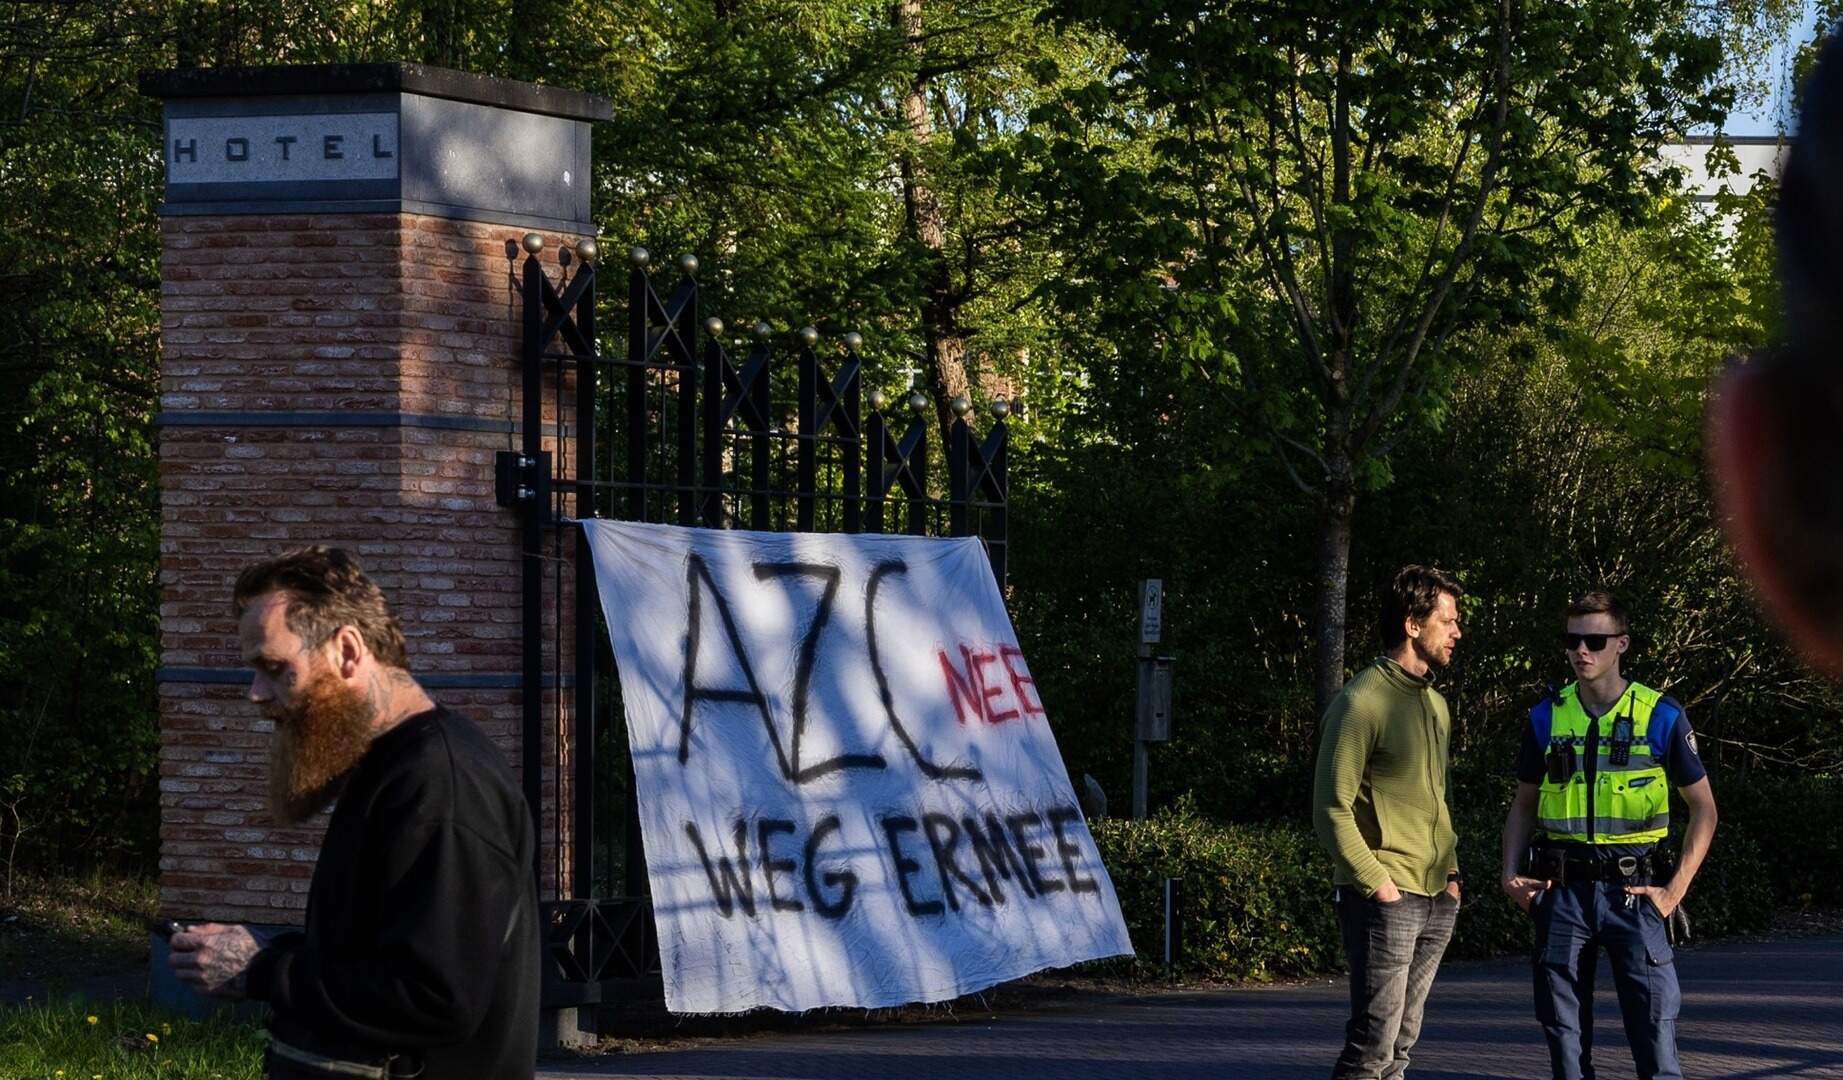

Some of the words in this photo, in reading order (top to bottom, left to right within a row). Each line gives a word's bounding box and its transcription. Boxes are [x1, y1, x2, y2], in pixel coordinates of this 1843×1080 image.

[174, 133, 393, 163] HOTEL
[678, 553, 984, 785] AZC
[937, 643, 1044, 727] NEE
[686, 815, 859, 920] WEG
[882, 807, 1098, 917] ERMEE
